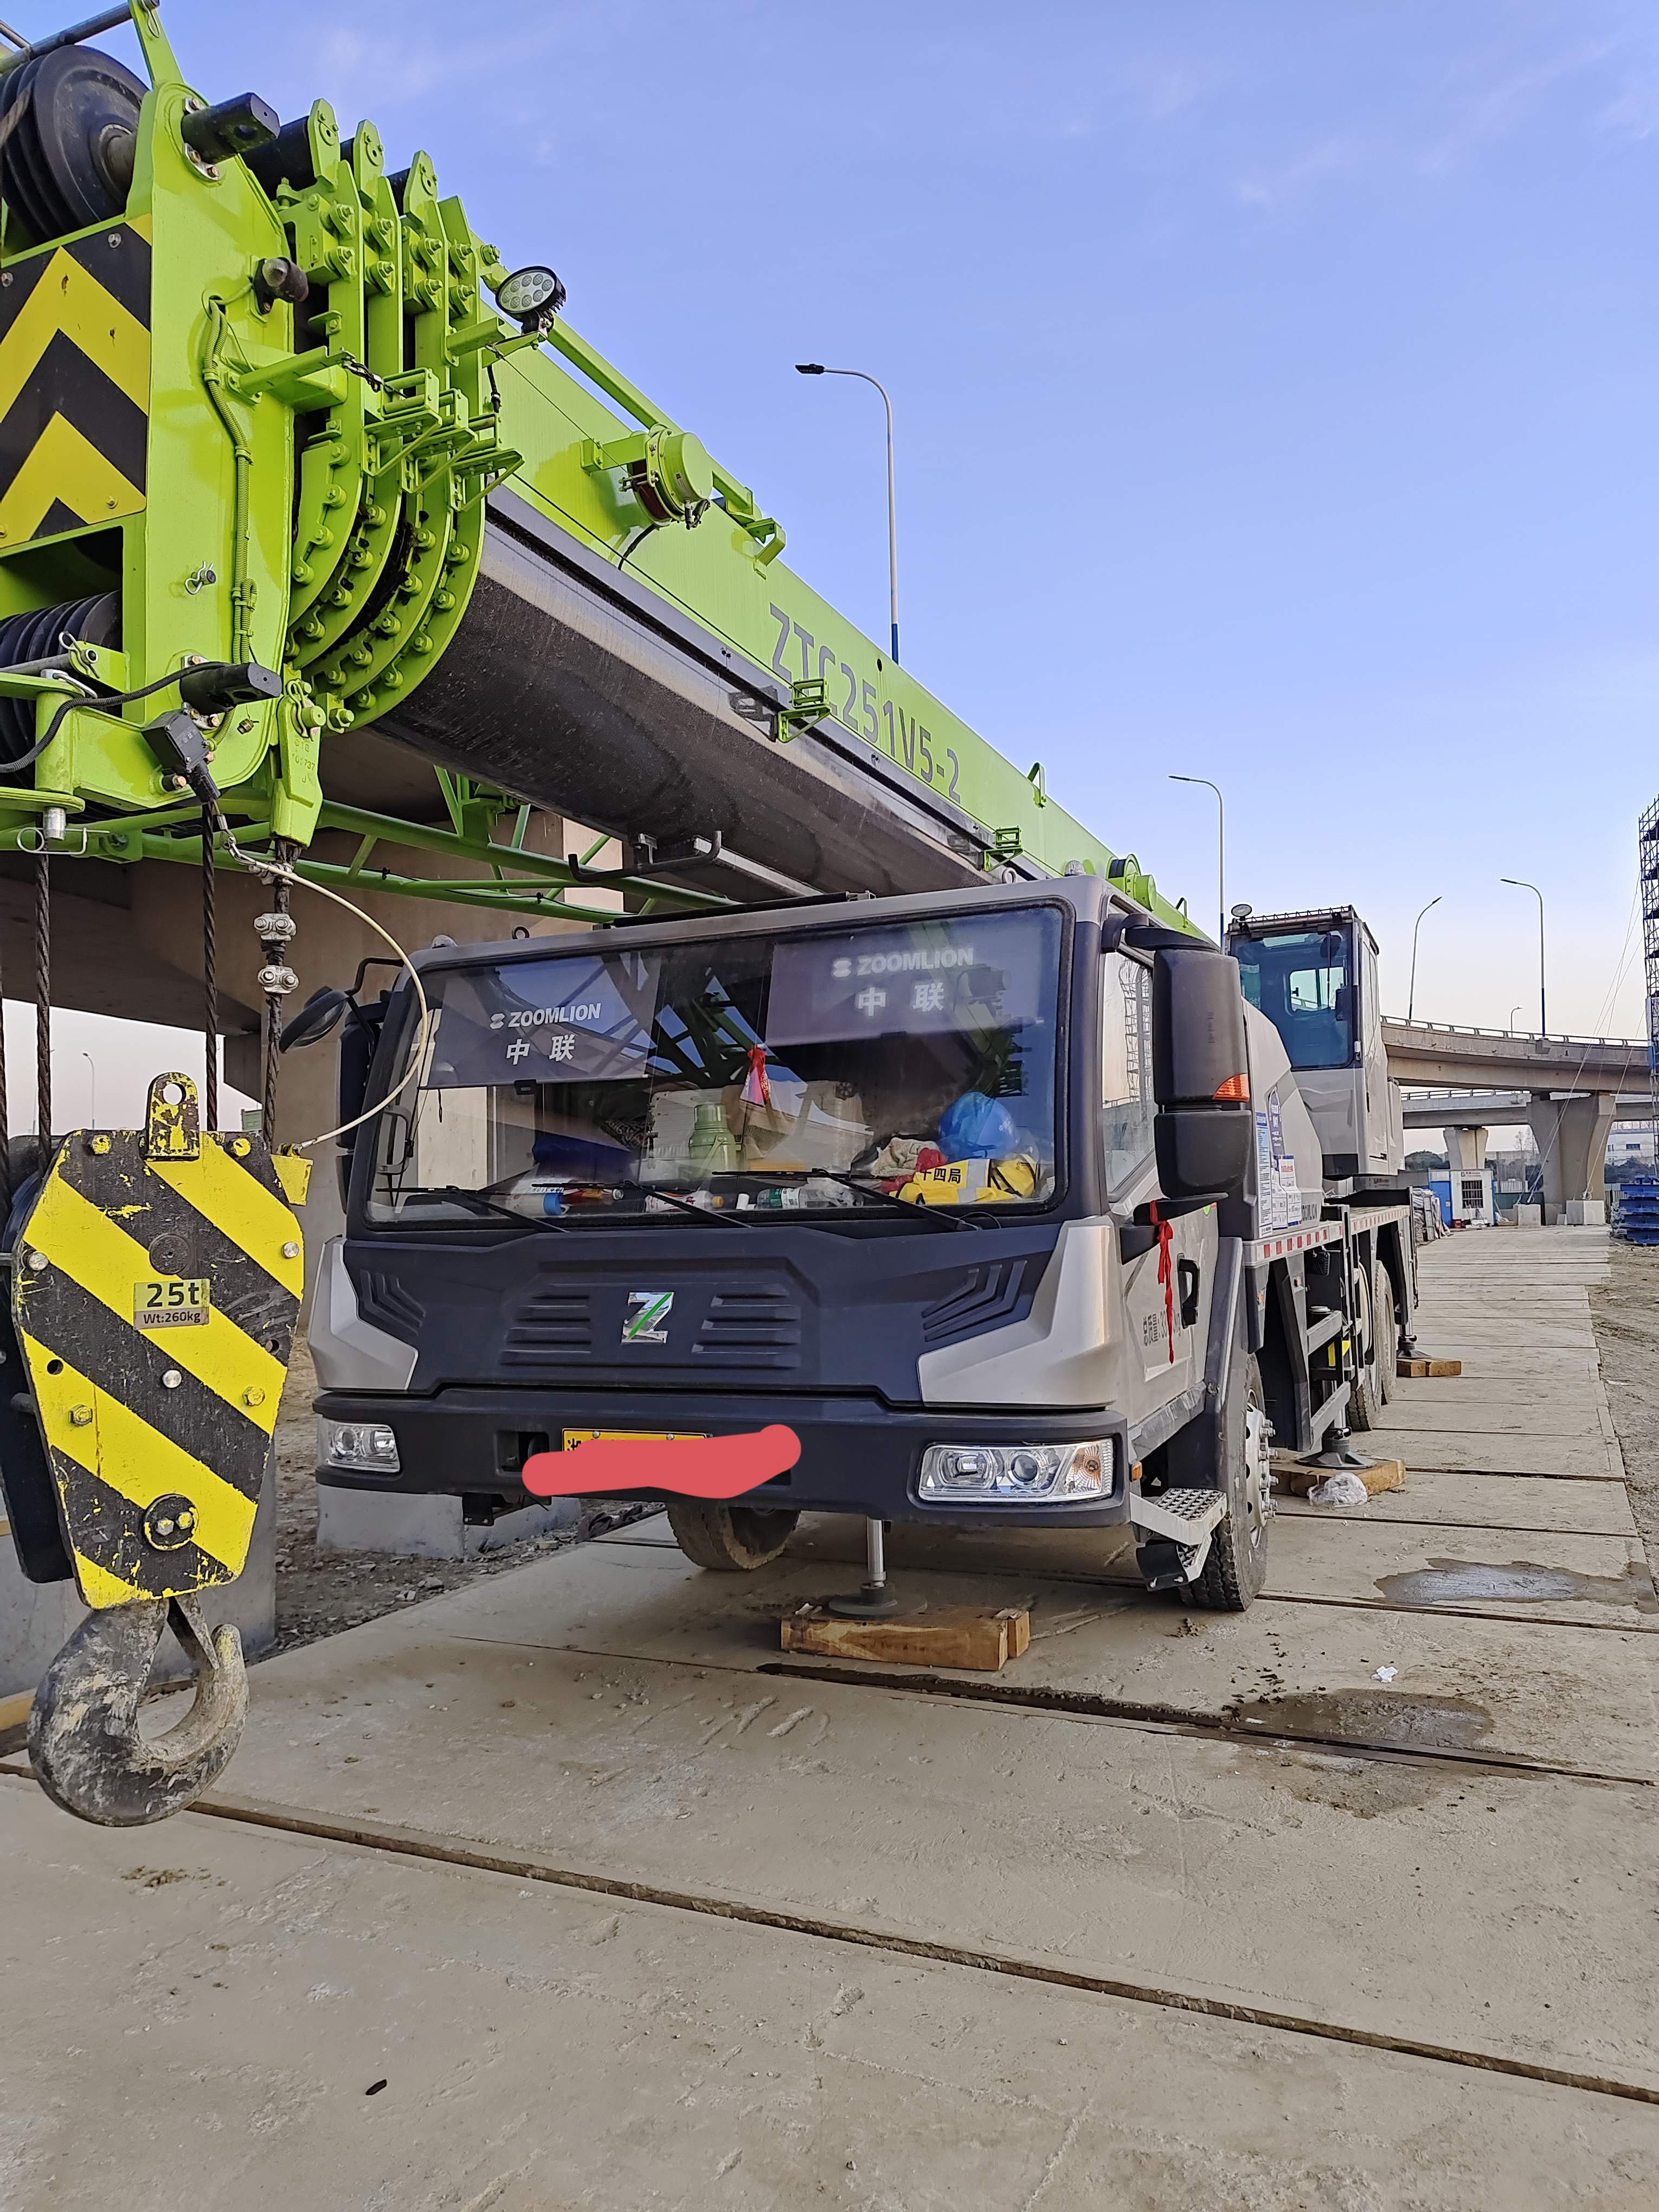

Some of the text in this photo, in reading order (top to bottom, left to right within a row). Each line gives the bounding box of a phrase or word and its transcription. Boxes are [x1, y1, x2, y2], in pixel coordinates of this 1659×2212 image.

[857, 948, 974, 975] ZOOMLION
[507, 1003, 602, 1028] ZOOMLION
[919, 1168, 961, 1184] 十四局
[146, 1282, 200, 1308] 25t
[143, 1311, 201, 1324] Wt:260kg
